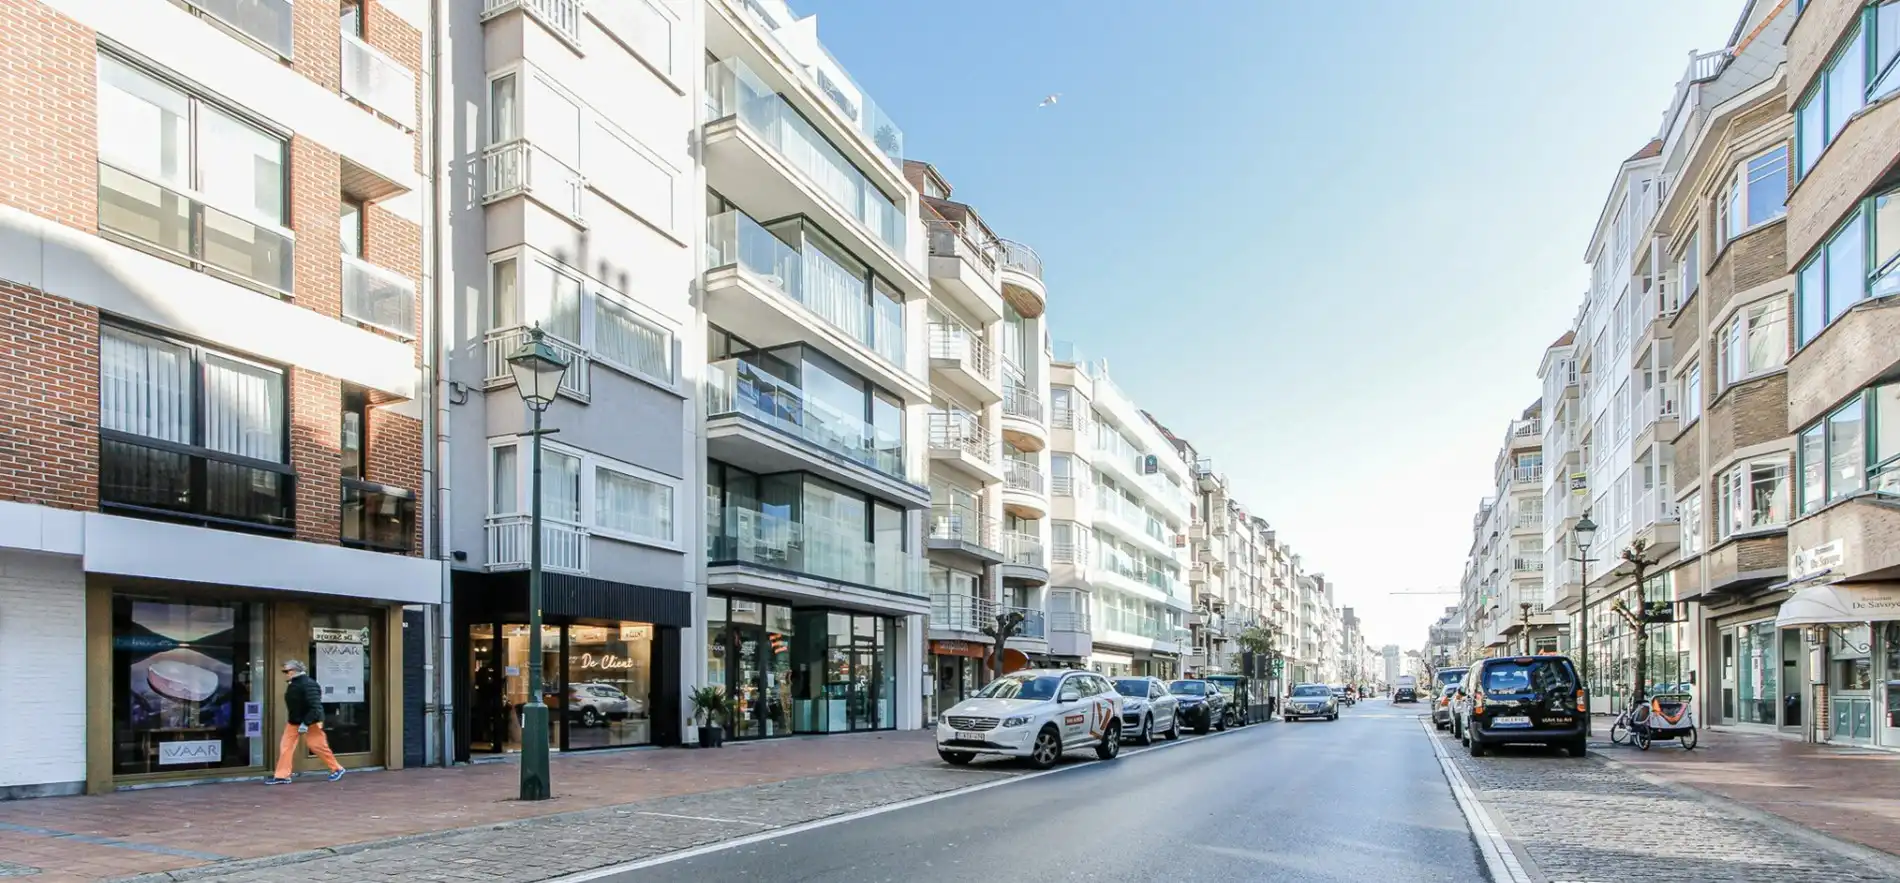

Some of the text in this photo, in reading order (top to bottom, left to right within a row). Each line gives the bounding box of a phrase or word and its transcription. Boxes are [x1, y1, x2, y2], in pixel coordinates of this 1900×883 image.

[1852, 602, 1866, 610] De
[321, 645, 360, 656] WAAR
[581, 653, 598, 670] De
[601, 655, 634, 670] Client
[164, 744, 219, 757] WAAR
